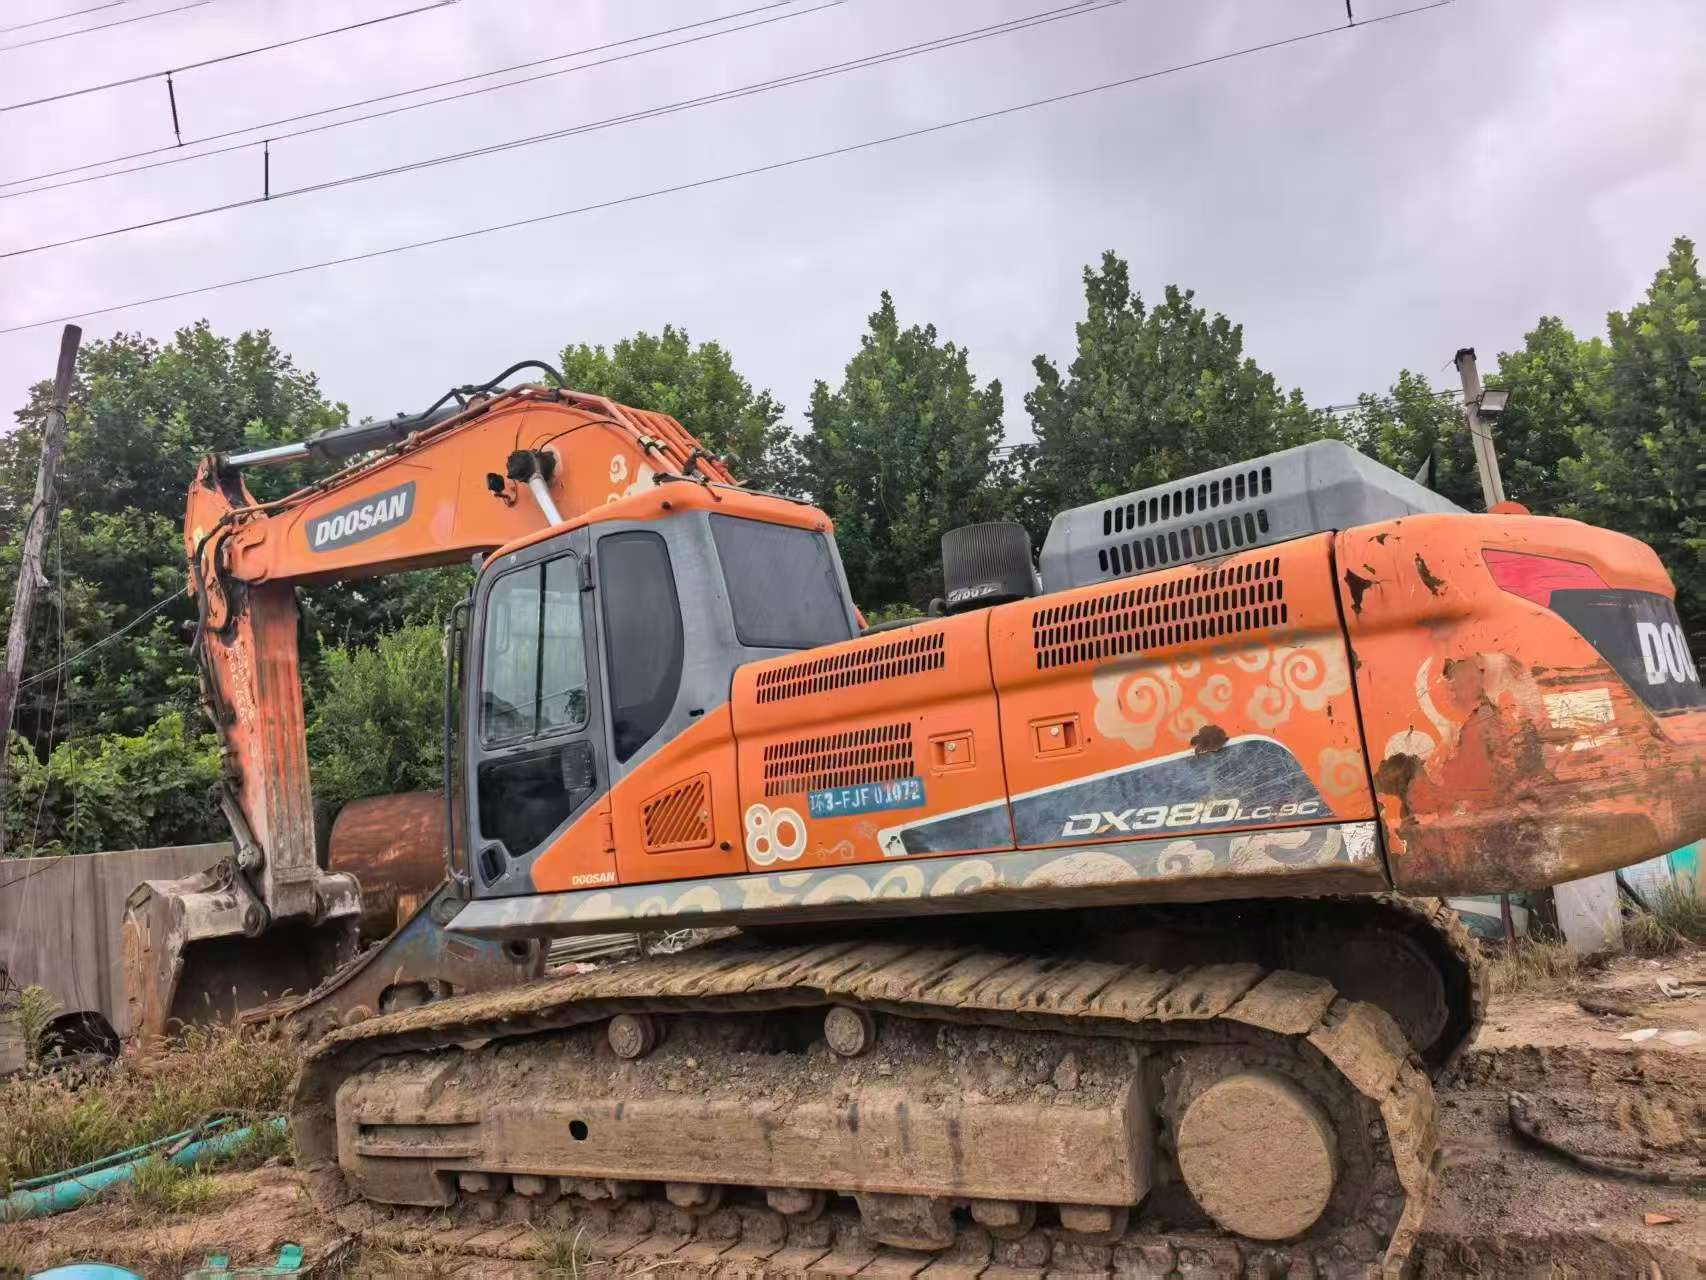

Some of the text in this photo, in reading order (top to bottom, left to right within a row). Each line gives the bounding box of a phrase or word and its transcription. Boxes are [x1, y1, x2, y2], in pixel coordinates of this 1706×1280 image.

[314, 492, 407, 546] DOOSAN
[1636, 622, 1700, 685] DOO
[744, 803, 807, 866] 80
[571, 871, 615, 886] DOOSAN
